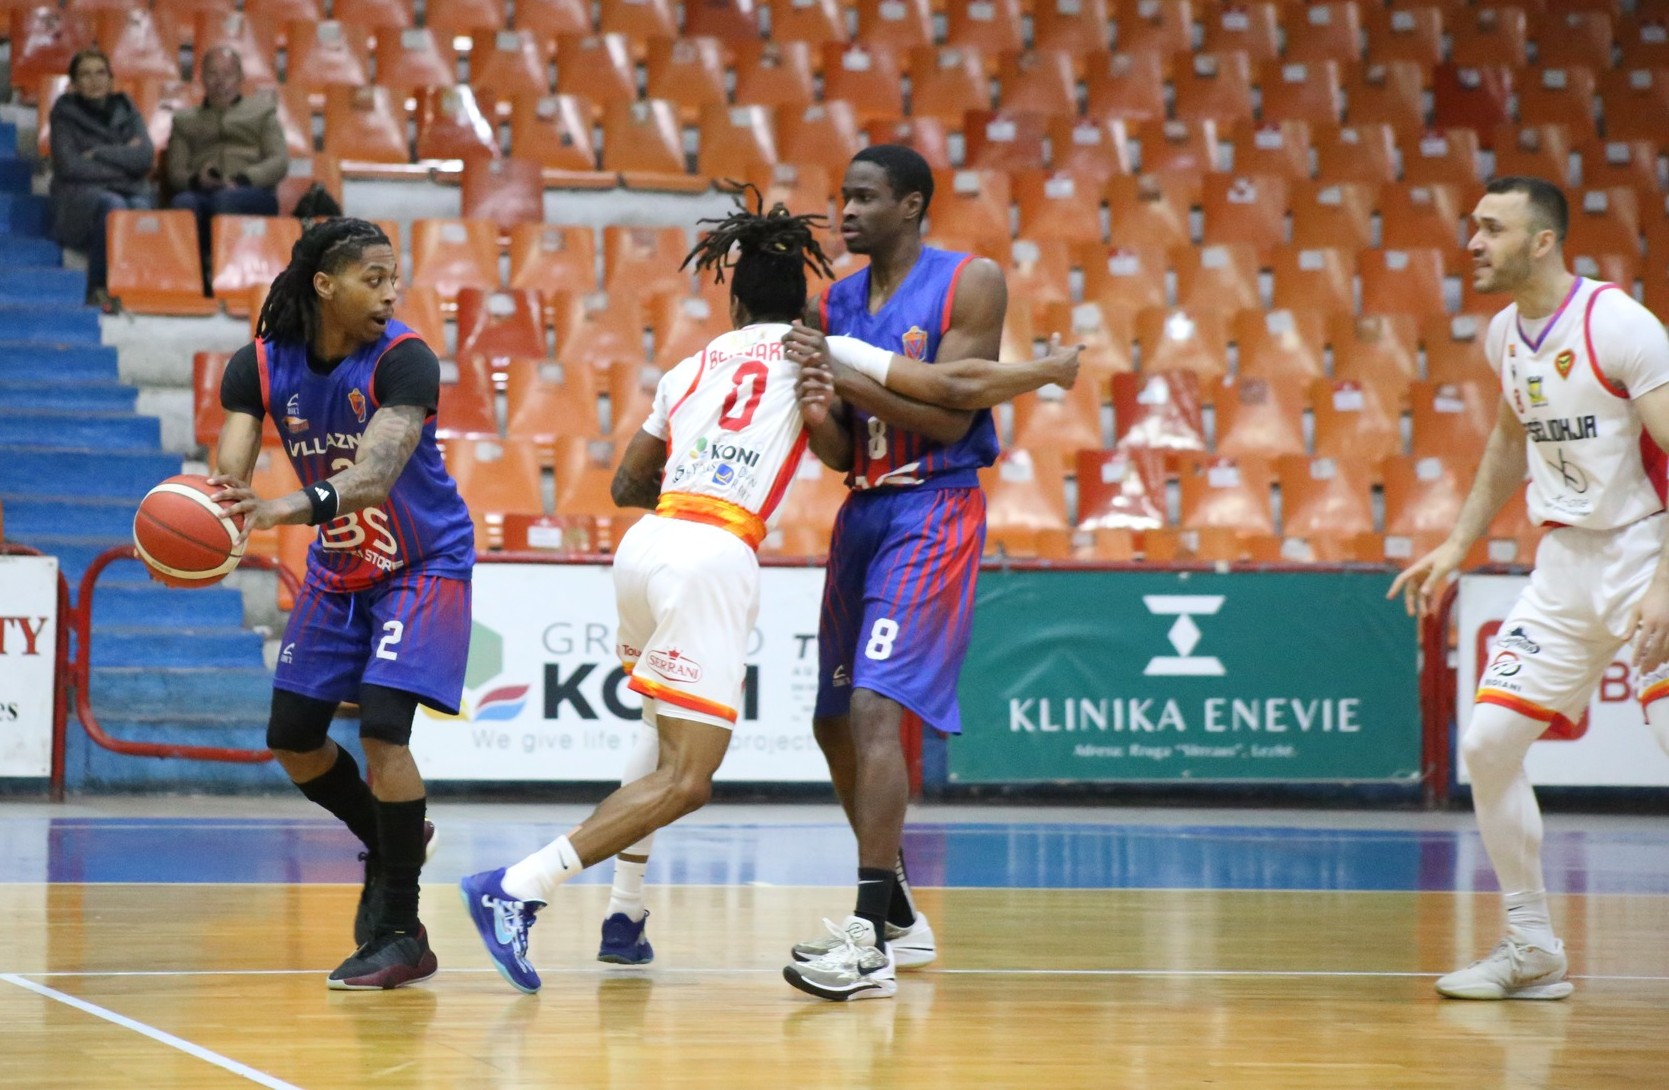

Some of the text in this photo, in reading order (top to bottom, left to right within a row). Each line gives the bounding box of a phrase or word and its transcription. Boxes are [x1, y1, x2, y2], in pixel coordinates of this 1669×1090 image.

[718, 360, 769, 432] 0
[288, 431, 362, 457] VLLAZN
[867, 415, 888, 460] 8
[711, 444, 760, 468] KONI
[376, 620, 404, 661] 2
[865, 617, 899, 661] 8
[649, 654, 699, 679] SERRANI
[1009, 698, 1362, 733] KLINIKA ENEVIE
[471, 730, 511, 749] We
[522, 730, 573, 754] give
[583, 730, 621, 749] life
